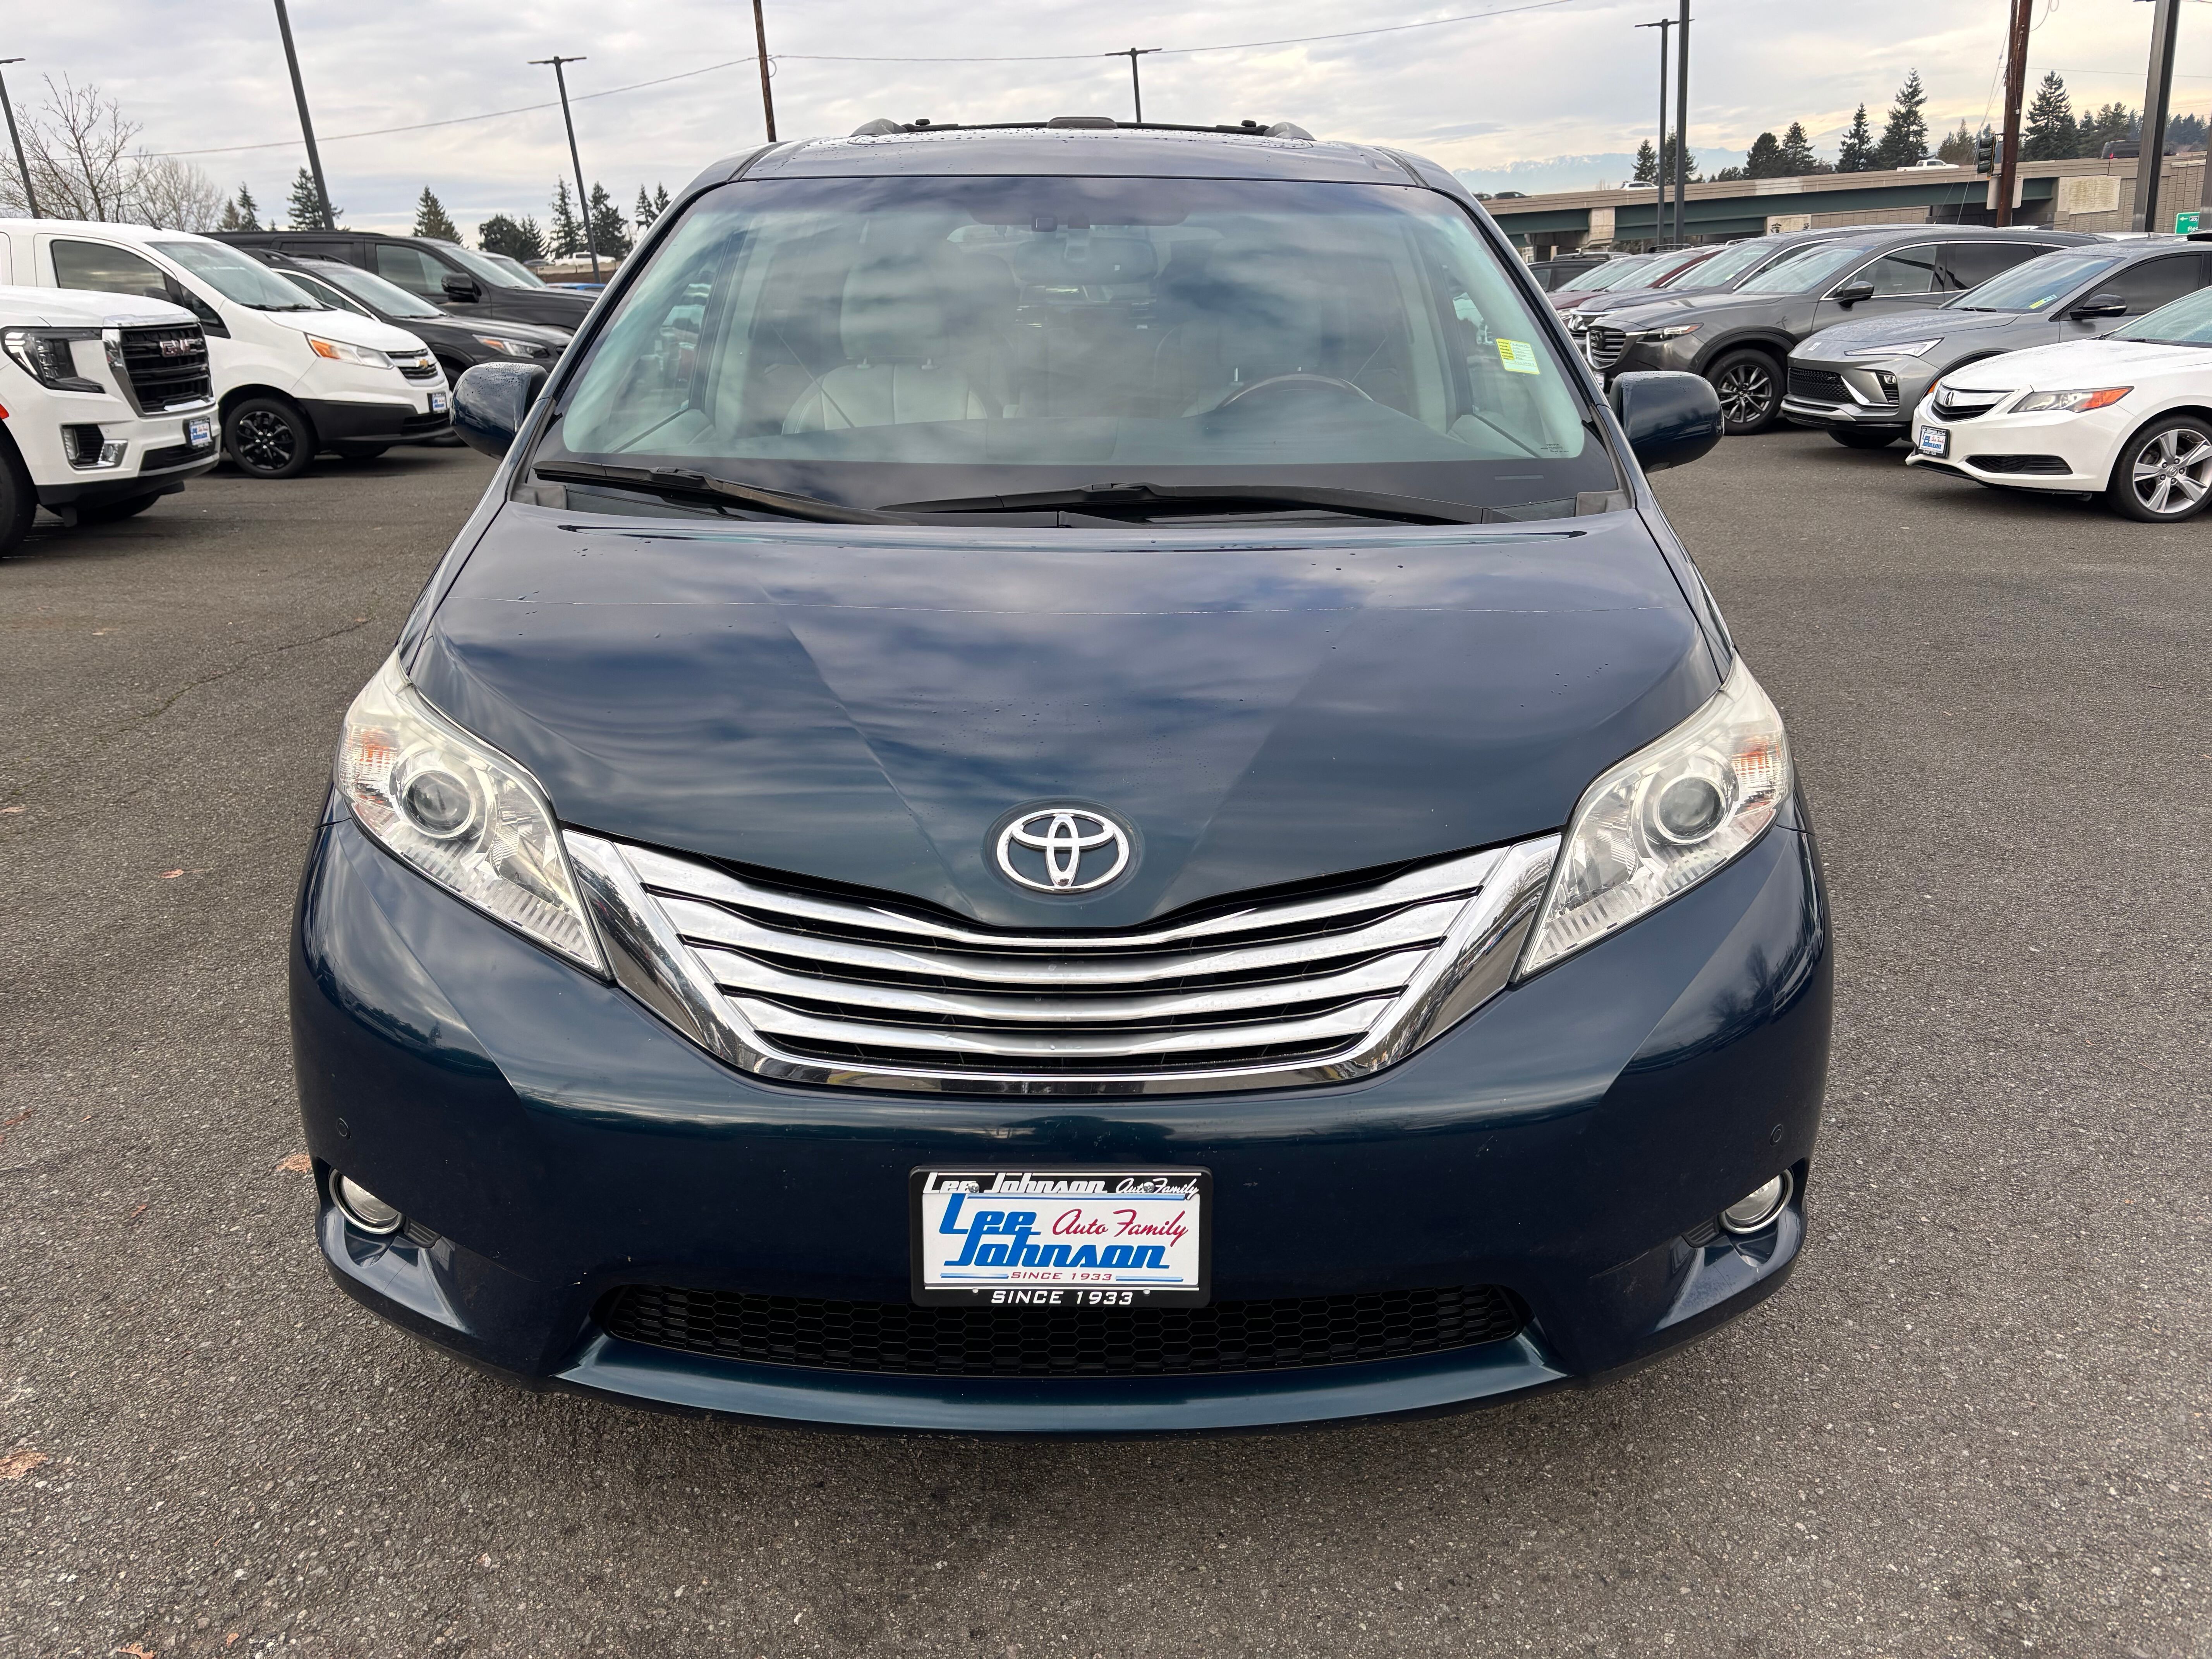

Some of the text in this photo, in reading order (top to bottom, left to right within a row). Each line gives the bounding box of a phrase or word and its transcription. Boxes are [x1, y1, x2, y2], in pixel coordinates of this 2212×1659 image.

[984, 1172, 1108, 1194] Johnson
[1116, 1178, 1154, 1194] Aut
[1152, 1177, 1199, 1200] Family
[939, 1193, 1042, 1235] Lee
[1052, 1208, 1189, 1247] Auto Family
[943, 1227, 1170, 1269] Johnson
[1011, 1271, 1112, 1281] SINCE 1933
[991, 1290, 1133, 1305] SINCE 1933
